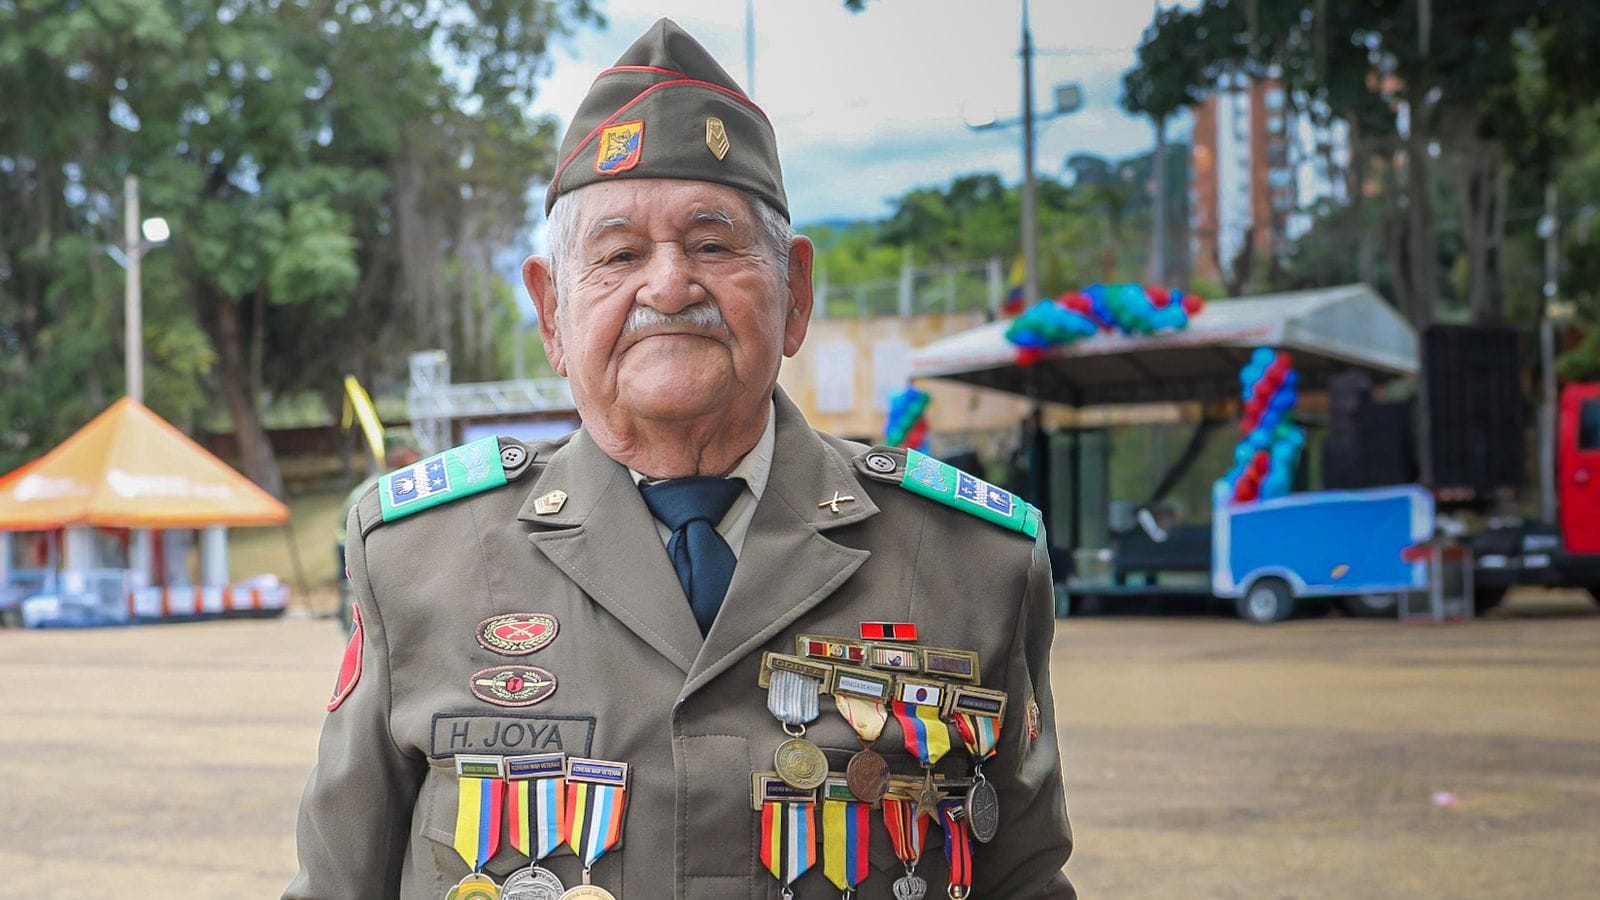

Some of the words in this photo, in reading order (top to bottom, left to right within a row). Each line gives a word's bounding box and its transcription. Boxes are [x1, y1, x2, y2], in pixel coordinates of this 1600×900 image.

[450, 721, 473, 748] H.
[483, 721, 564, 751] JOYA
[541, 761, 561, 769] VETERAN
[601, 769, 622, 777] VETERAN
